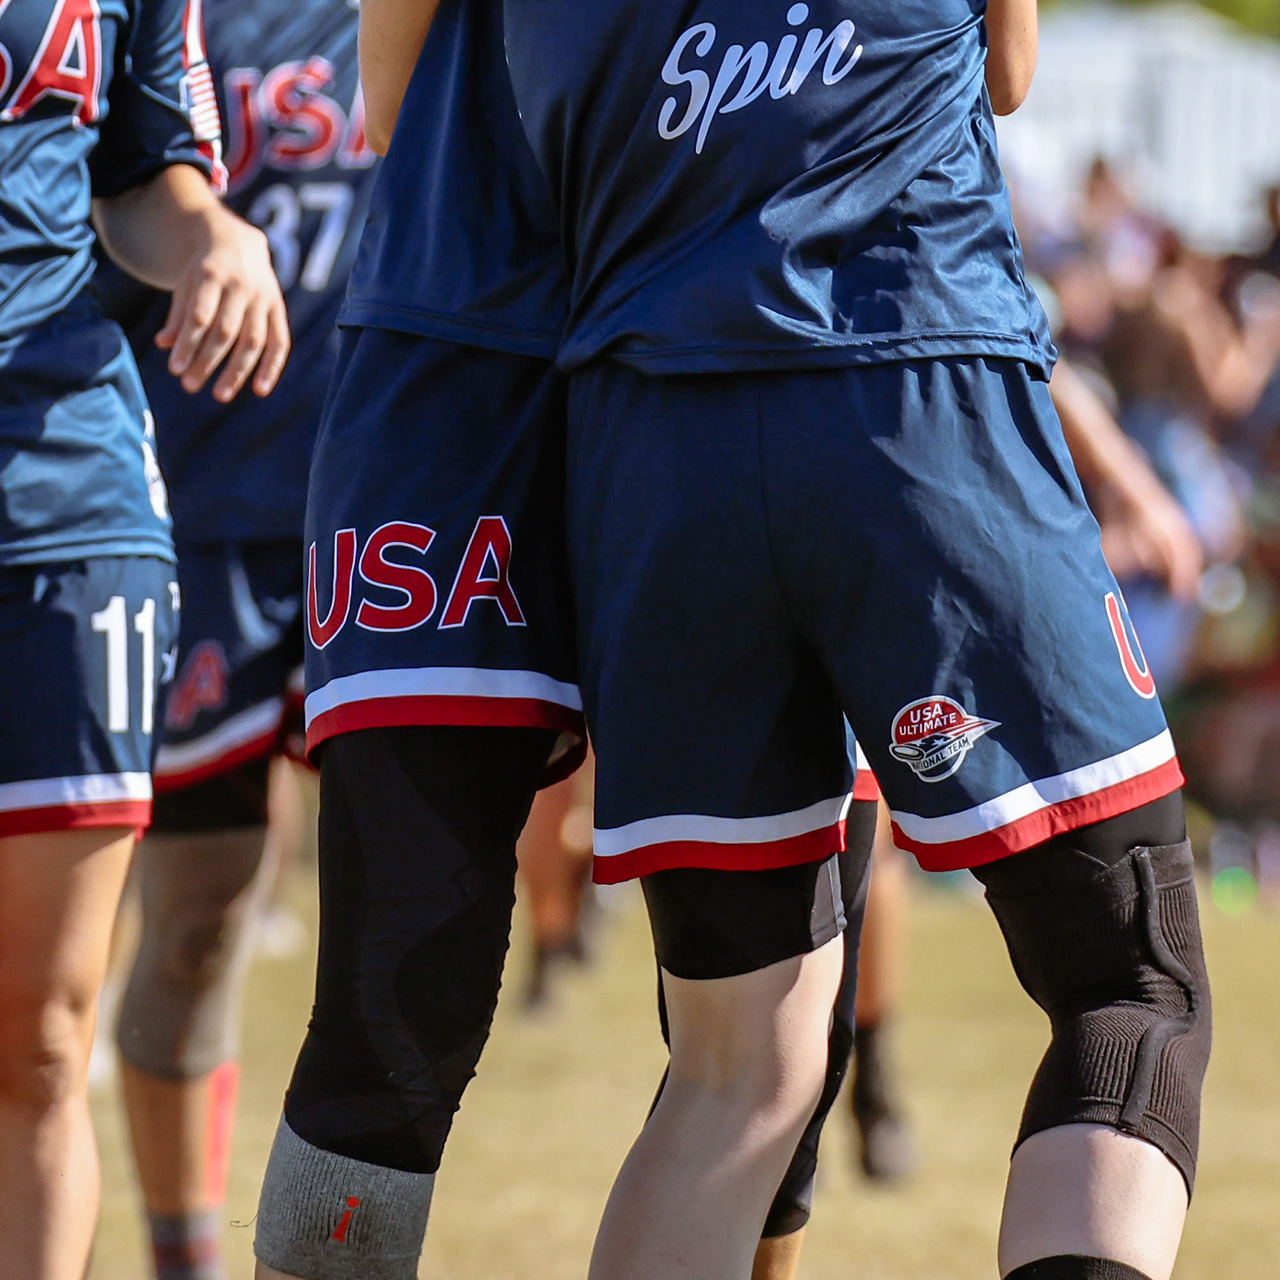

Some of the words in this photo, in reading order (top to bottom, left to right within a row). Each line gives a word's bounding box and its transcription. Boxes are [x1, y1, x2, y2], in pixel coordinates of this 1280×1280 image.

[657, 2, 863, 155] Spin
[248, 182, 354, 292] 37
[308, 516, 527, 650] USA
[91, 595, 156, 734] 11
[910, 703, 942, 723] USA
[900, 712, 957, 735] ULTIMATE
[948, 737, 970, 754] TEAM
